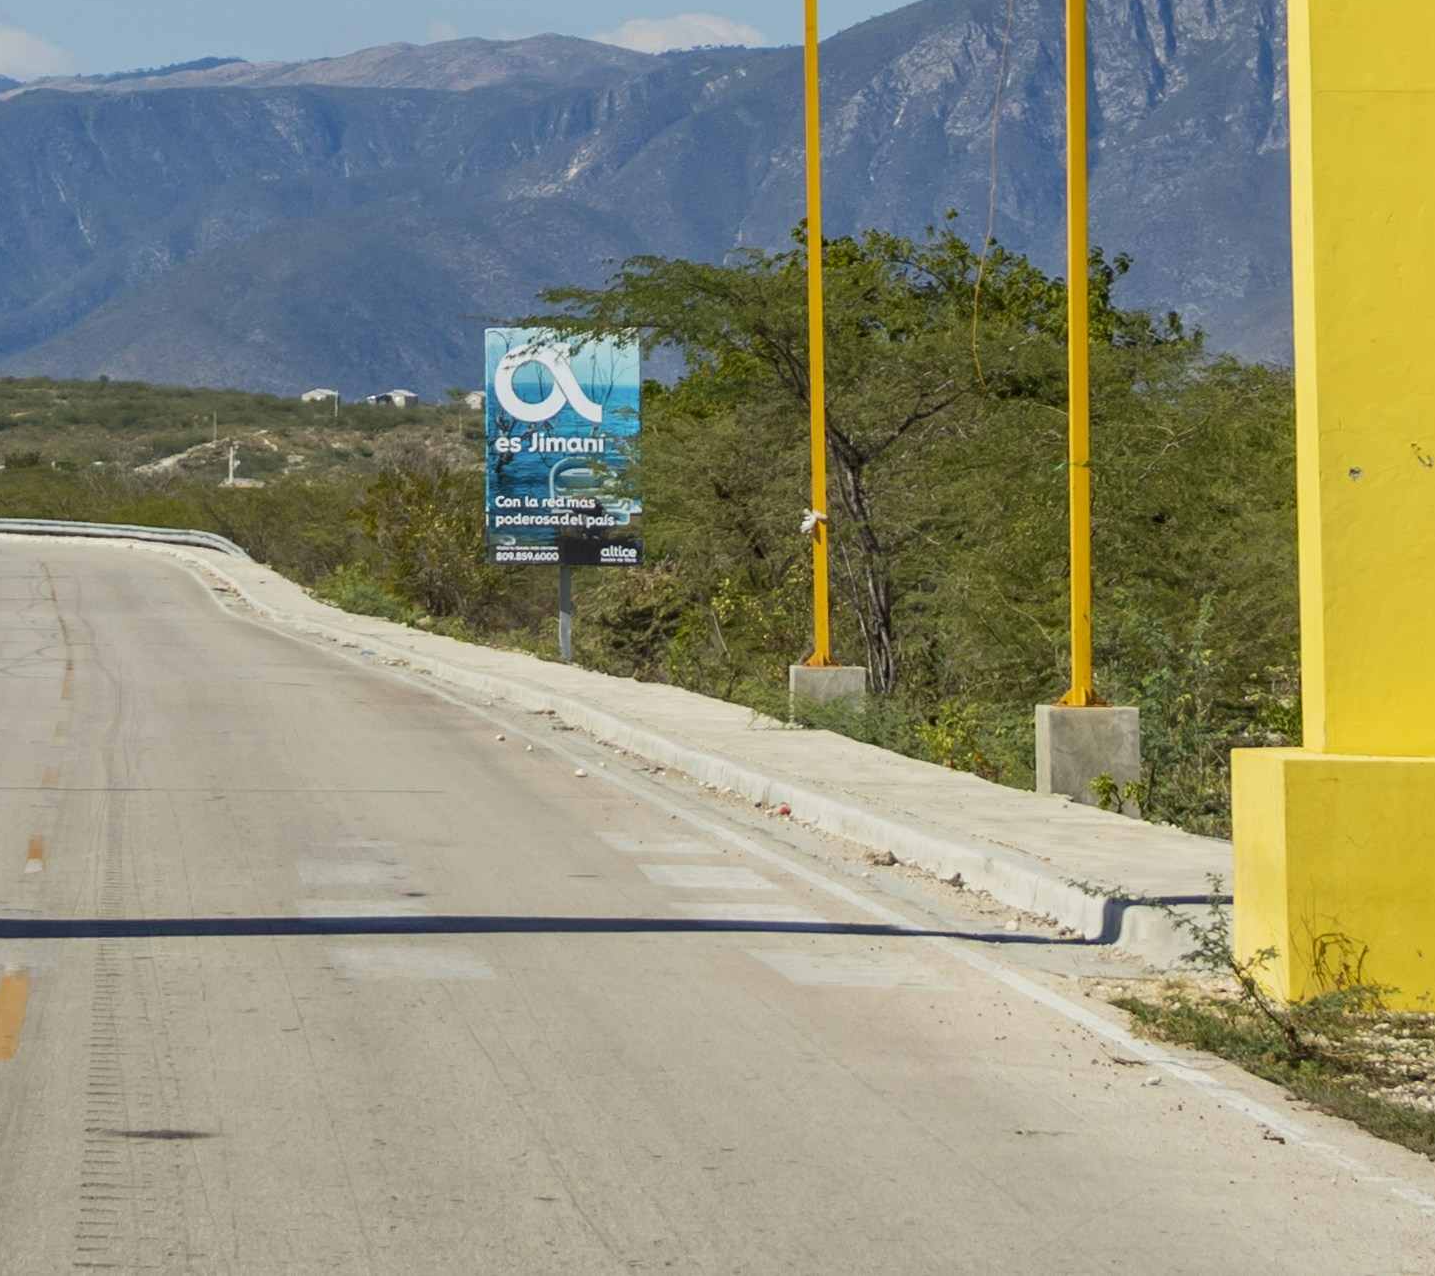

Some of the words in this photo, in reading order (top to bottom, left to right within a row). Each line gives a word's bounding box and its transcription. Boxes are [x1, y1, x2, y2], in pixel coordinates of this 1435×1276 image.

[495, 437, 522, 453] es
[495, 495, 521, 508] Con
[525, 495, 539, 508] la
[542, 496, 565, 508] red
[495, 514, 560, 528] poderosa
[560, 514, 583, 526] del
[496, 552, 560, 561] 809.859.6000
[601, 545, 637, 557] altice
